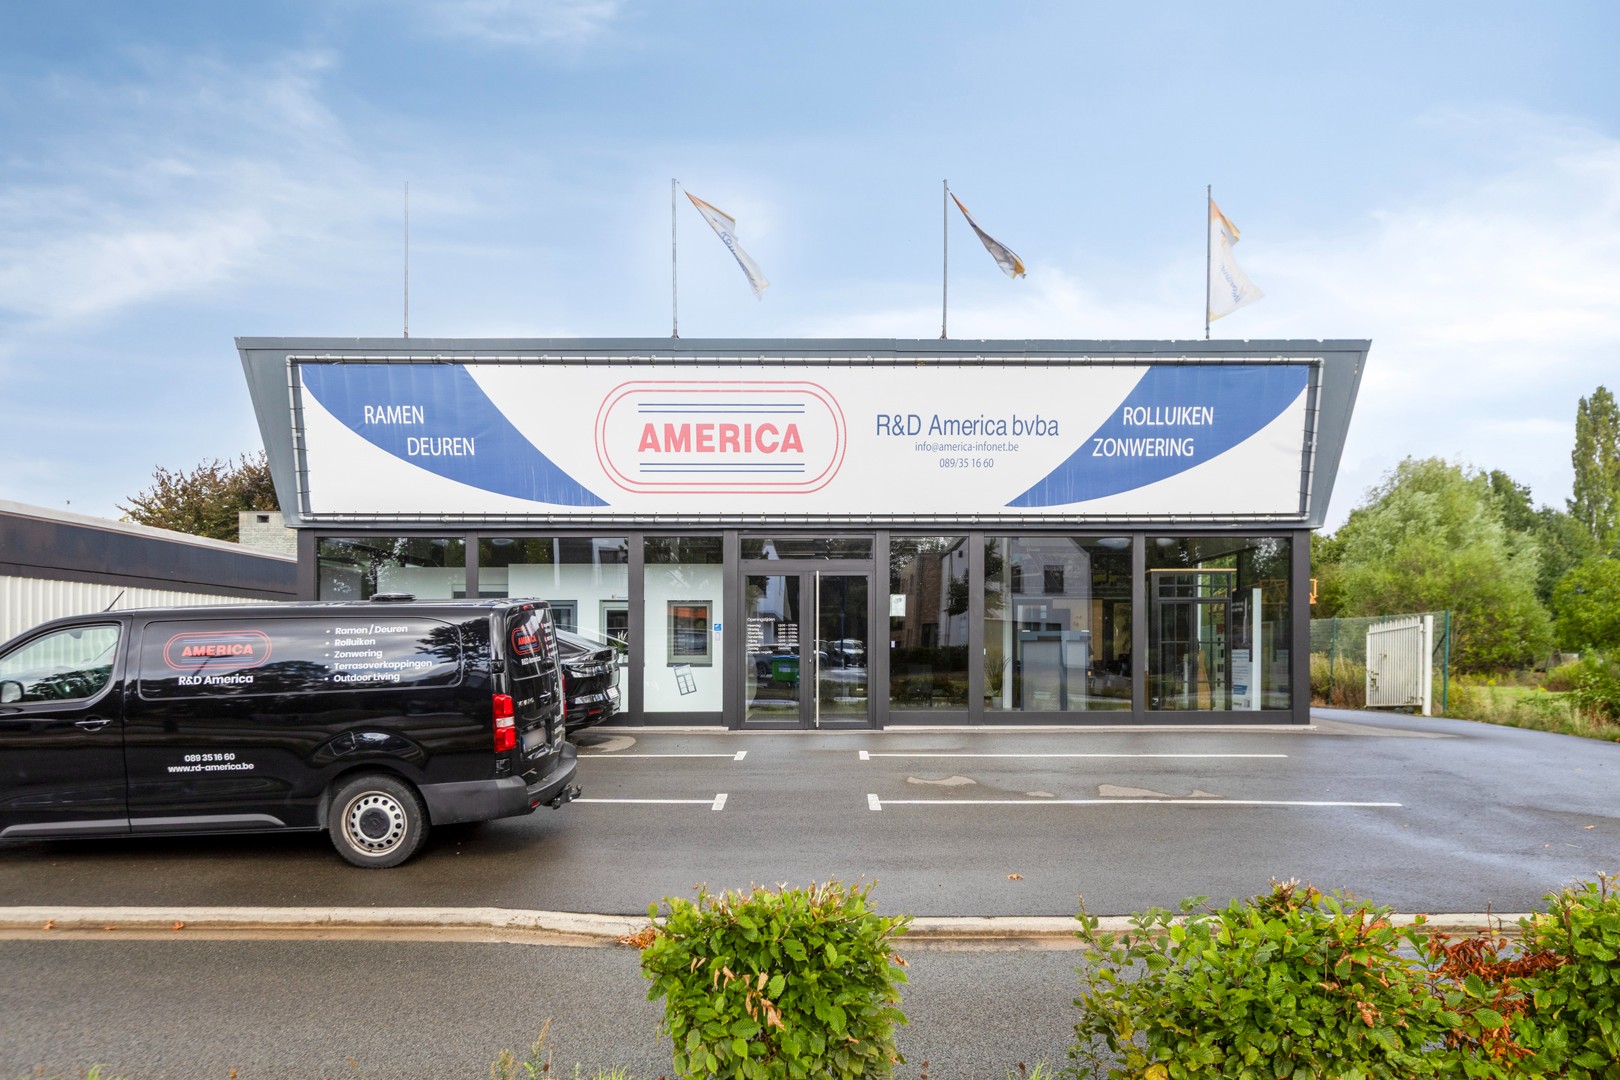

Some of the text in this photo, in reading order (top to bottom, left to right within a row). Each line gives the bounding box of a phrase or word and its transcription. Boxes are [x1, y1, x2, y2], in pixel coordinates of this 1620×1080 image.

[364, 405, 424, 424] RAMEN
[1123, 406, 1214, 425] ROLLUIKEN
[876, 414, 1059, 436] R&D America bvba
[637, 423, 804, 454] AMERICA
[407, 437, 475, 456] DEUREN
[915, 441, 1019, 452] info@america-infonet.be
[1092, 438, 1195, 457] ZONWERING
[939, 458, 994, 468] 089/35 16 60
[335, 627, 368, 635] Ramen
[374, 625, 408, 634] Deuren
[334, 638, 376, 647] Rolluiken
[181, 643, 254, 657] AMERICA
[334, 649, 383, 659] Zonwering
[333, 659, 433, 670] Terrasoverkappingen
[178, 673, 254, 686] R&D America
[333, 672, 401, 683] Outdoor Living
[184, 754, 201, 762] 089
[223, 753, 236, 761] 60
[167, 762, 255, 773] www.rd-america.be
